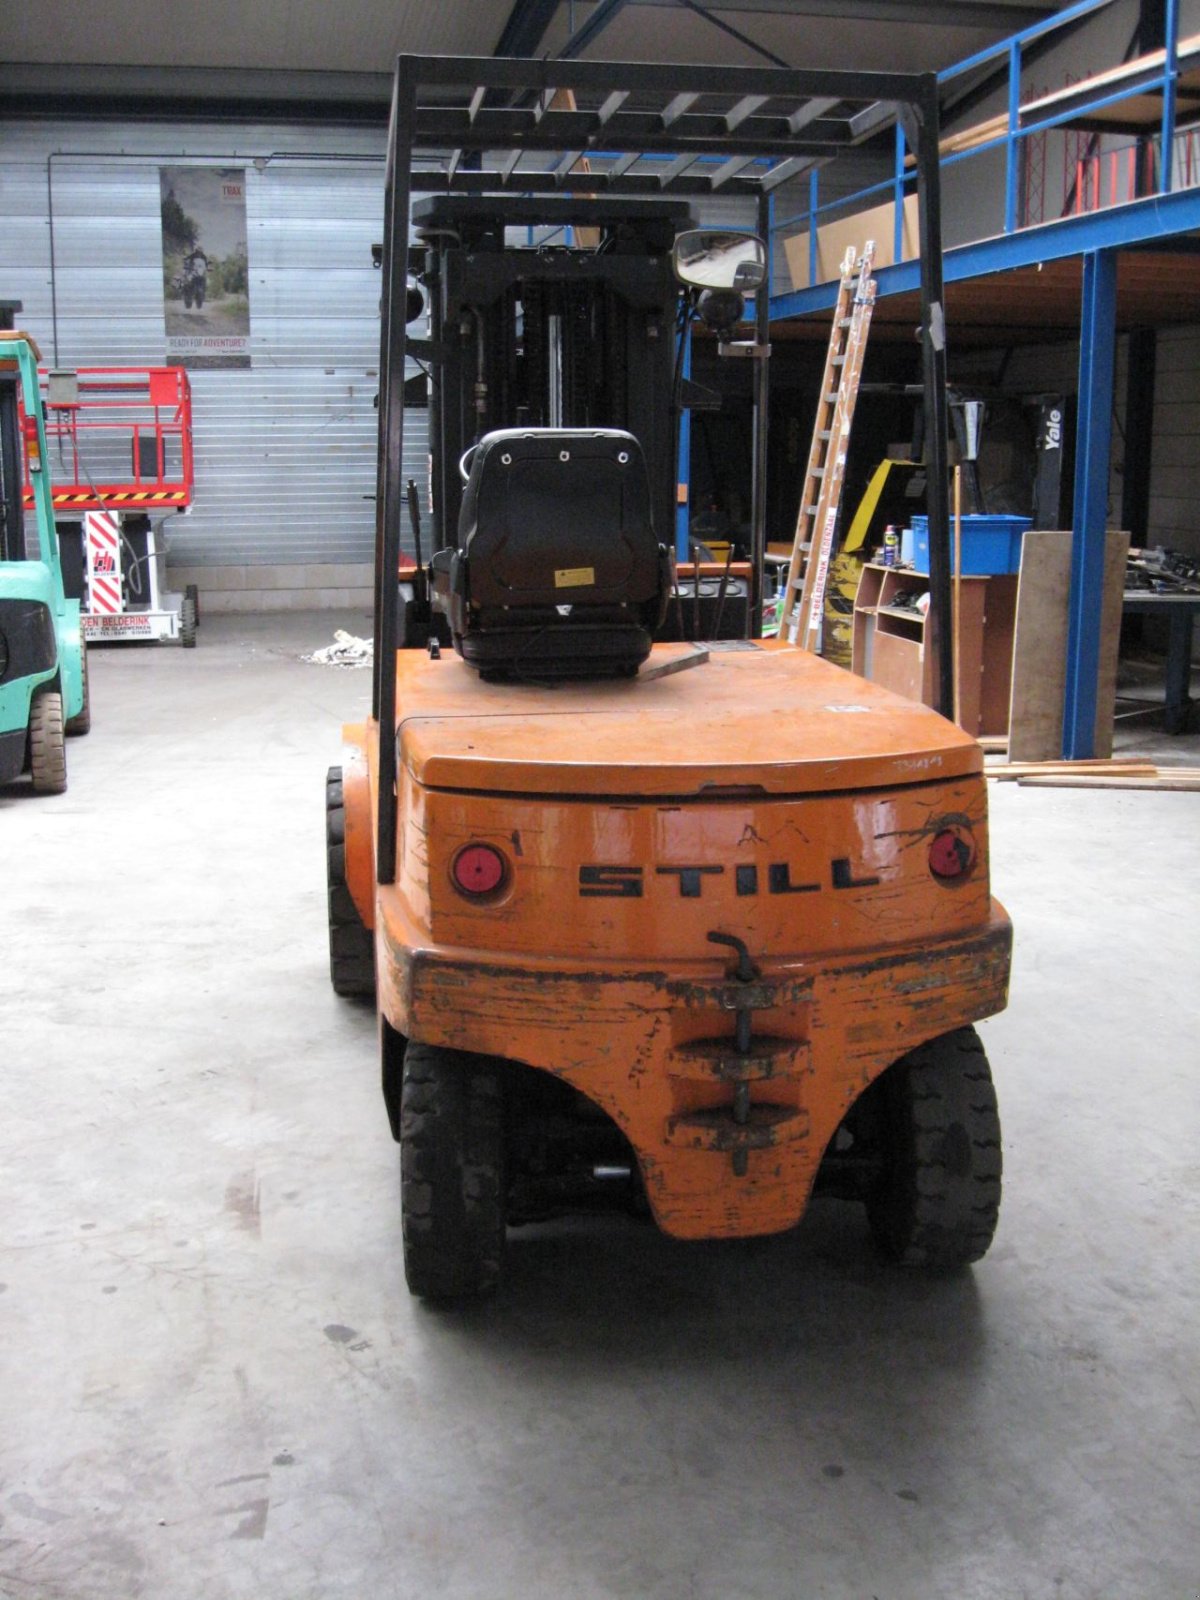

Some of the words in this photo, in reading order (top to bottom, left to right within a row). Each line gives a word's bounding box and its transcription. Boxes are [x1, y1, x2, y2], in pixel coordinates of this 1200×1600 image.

[169, 338, 190, 348] READY
[190, 338, 203, 348] FOR
[203, 338, 247, 348] ADVENTURE?
[1045, 409, 1061, 450] Yale
[813, 560, 827, 610] BELDERINK
[102, 615, 150, 627] BELDERINK
[579, 858, 880, 898] STILL
